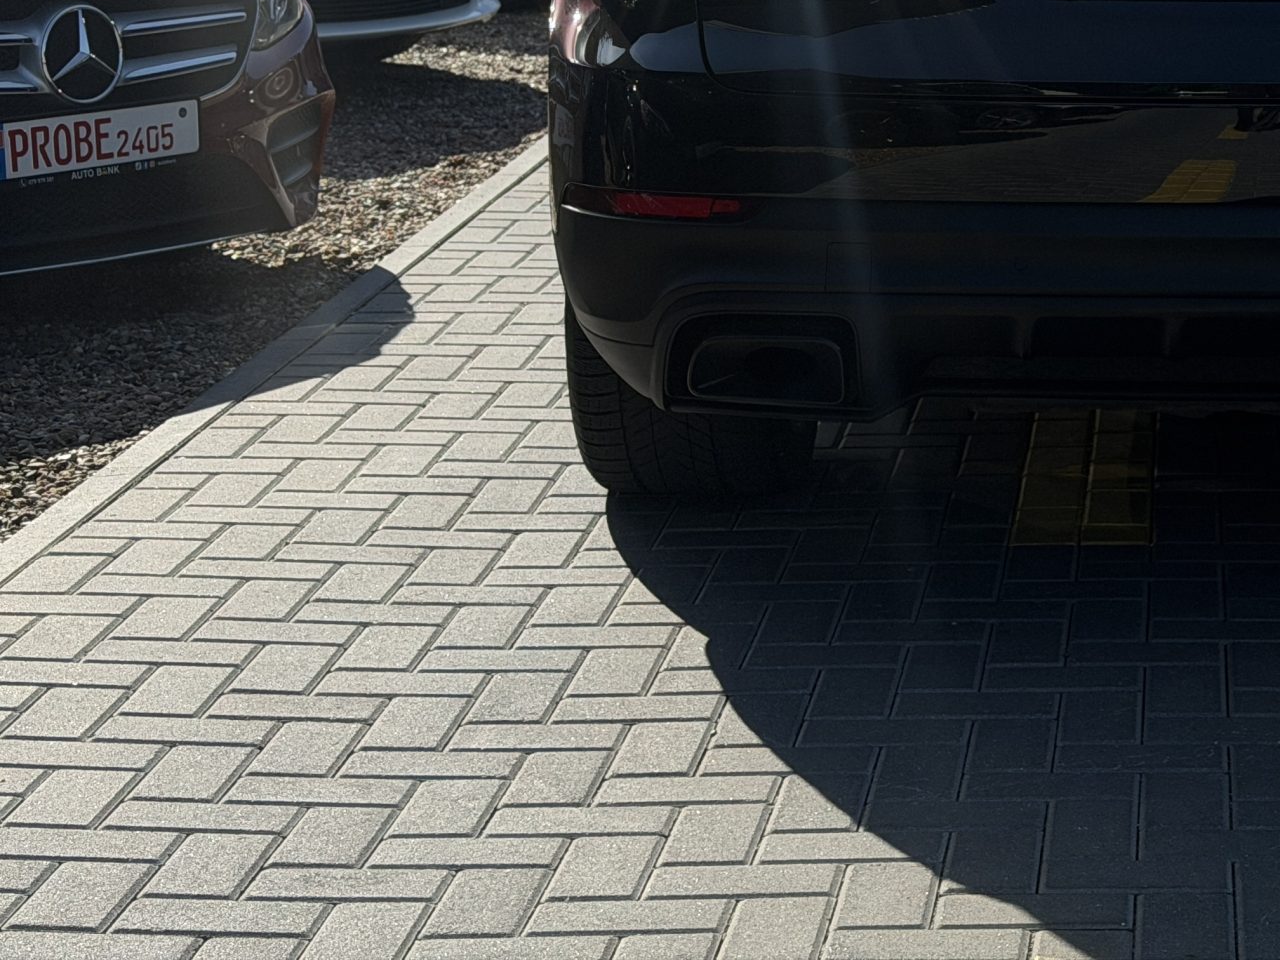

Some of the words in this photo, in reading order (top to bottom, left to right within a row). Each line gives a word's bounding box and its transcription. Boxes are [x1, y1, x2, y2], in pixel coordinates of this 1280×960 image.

[8, 117, 115, 173] PROBE
[116, 123, 174, 158] 2405
[71, 167, 94, 181] AUTO
